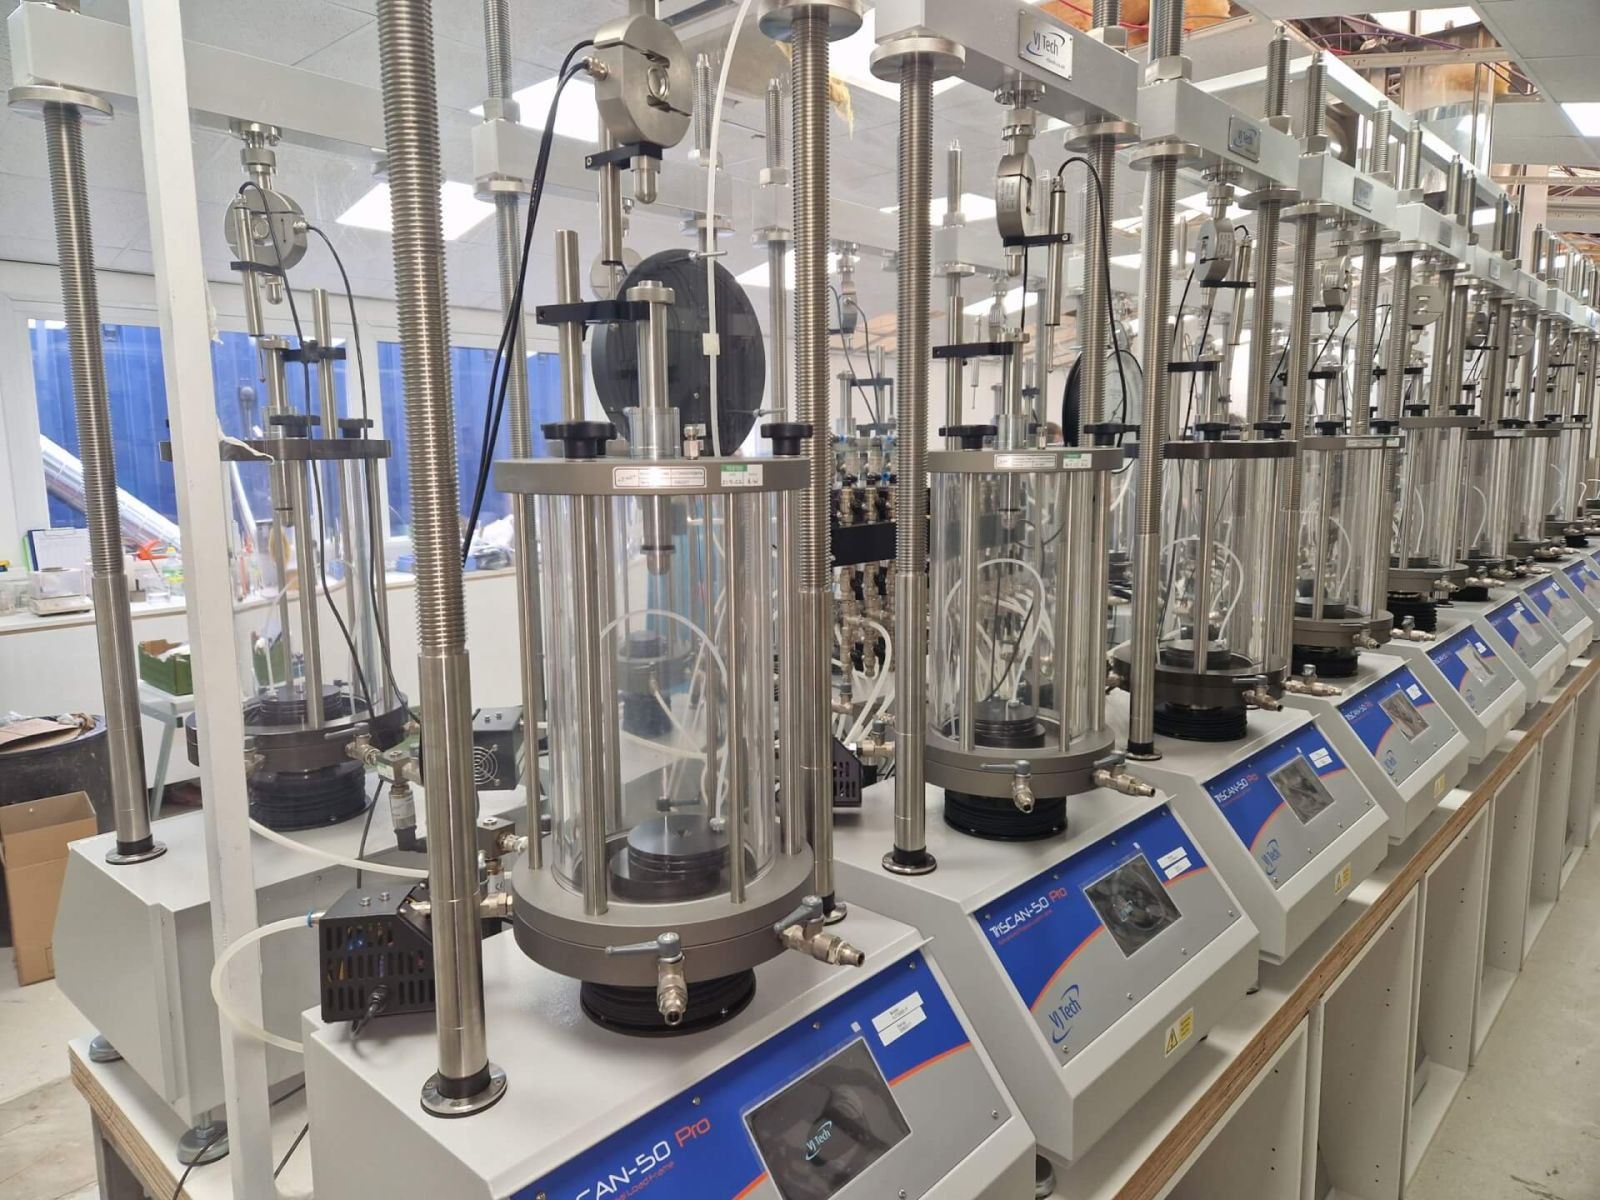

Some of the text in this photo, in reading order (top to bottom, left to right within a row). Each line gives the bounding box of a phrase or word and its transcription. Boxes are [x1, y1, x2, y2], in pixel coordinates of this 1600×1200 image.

[1033, 29, 1059, 57] VJ Tech
[1048, 887, 1068, 903] Pro
[1048, 996, 1082, 1030] VJ Tech
[674, 1117, 711, 1148] Pro
[814, 1128, 831, 1145] Tech
